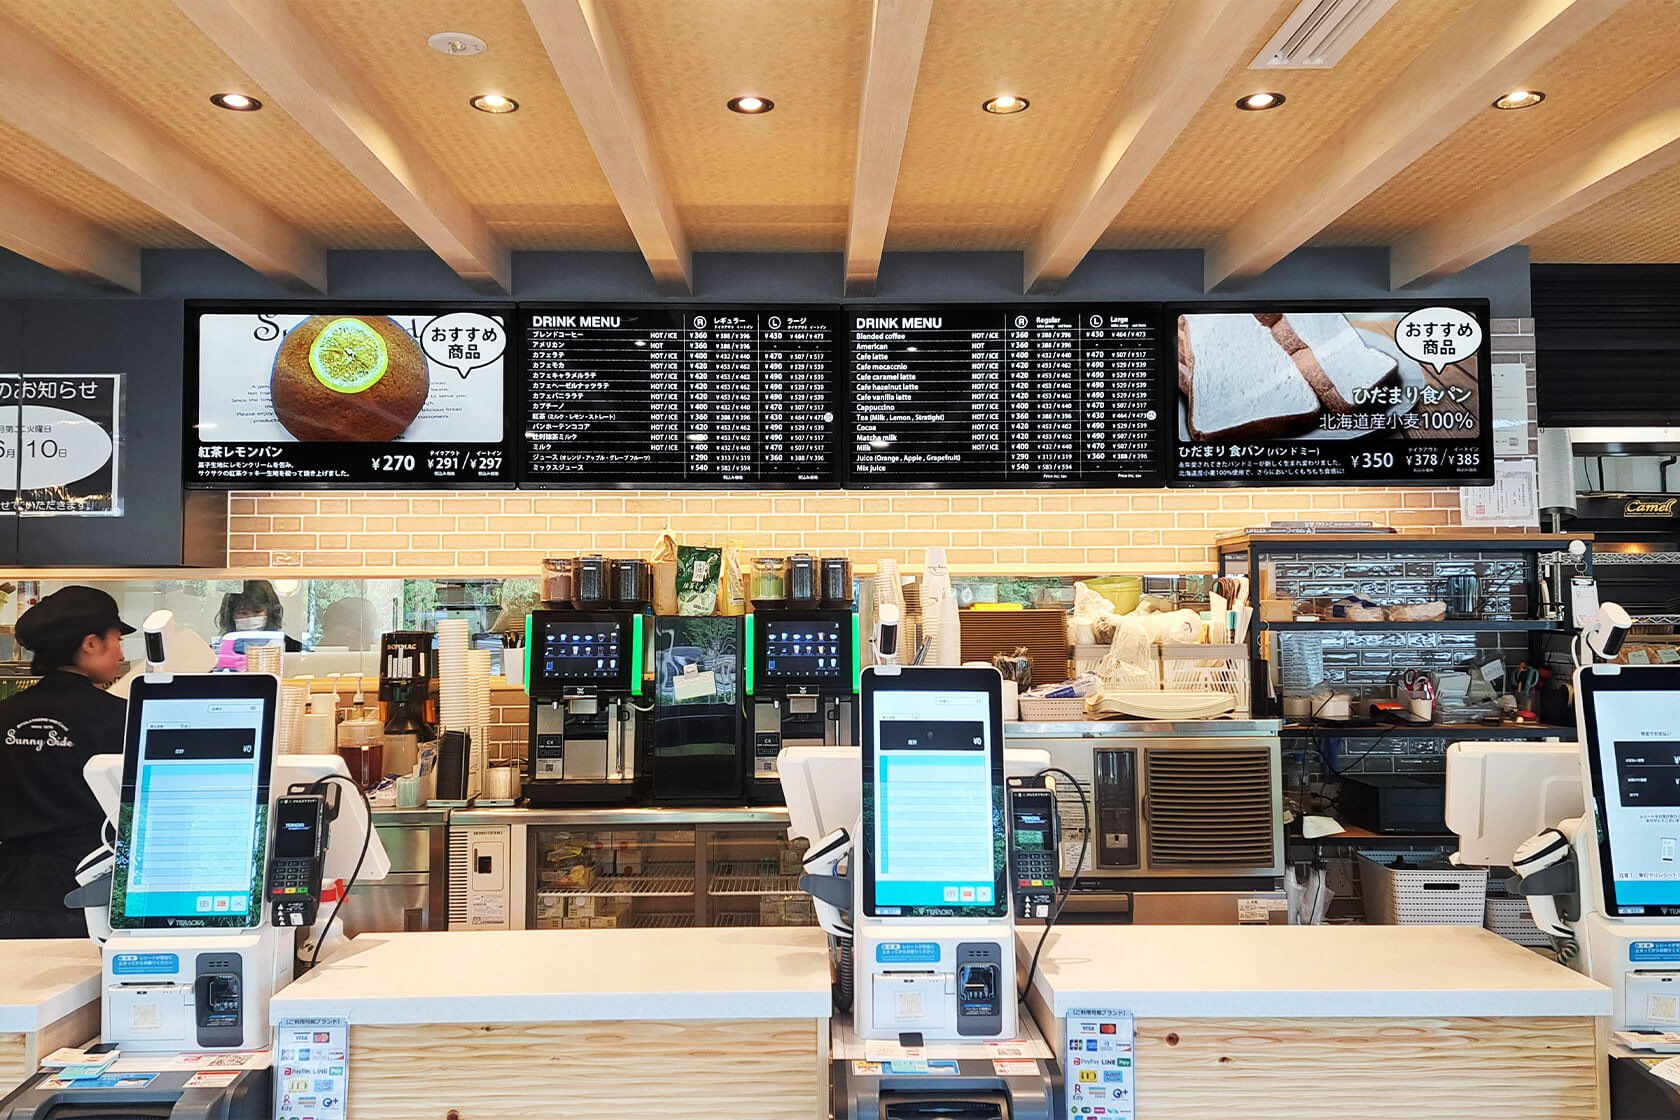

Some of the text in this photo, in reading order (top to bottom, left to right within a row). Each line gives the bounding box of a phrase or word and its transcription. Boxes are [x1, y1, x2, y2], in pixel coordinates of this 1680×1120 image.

[532, 316, 621, 328] DRINK MENU
[856, 317, 942, 329] DRINK MENU
[1405, 322, 1473, 338] おすすめ
[430, 326, 498, 343] おすすめ
[447, 343, 481, 360] 商品
[1423, 339, 1456, 356] 商品
[1352, 386, 1472, 406] ひだまり食パン
[1319, 412, 1473, 430] 北海道産小麦100%
[198, 446, 283, 458] 紅茶レモンパン
[1406, 454, 1479, 466] ¥378 ¥385
[371, 455, 416, 471] ¥270
[427, 458, 502, 469] ¥291 ¥297
[1351, 453, 1393, 468] ¥350
[1626, 498, 1677, 512] Camel
[5, 729, 74, 751] Sunny Side
